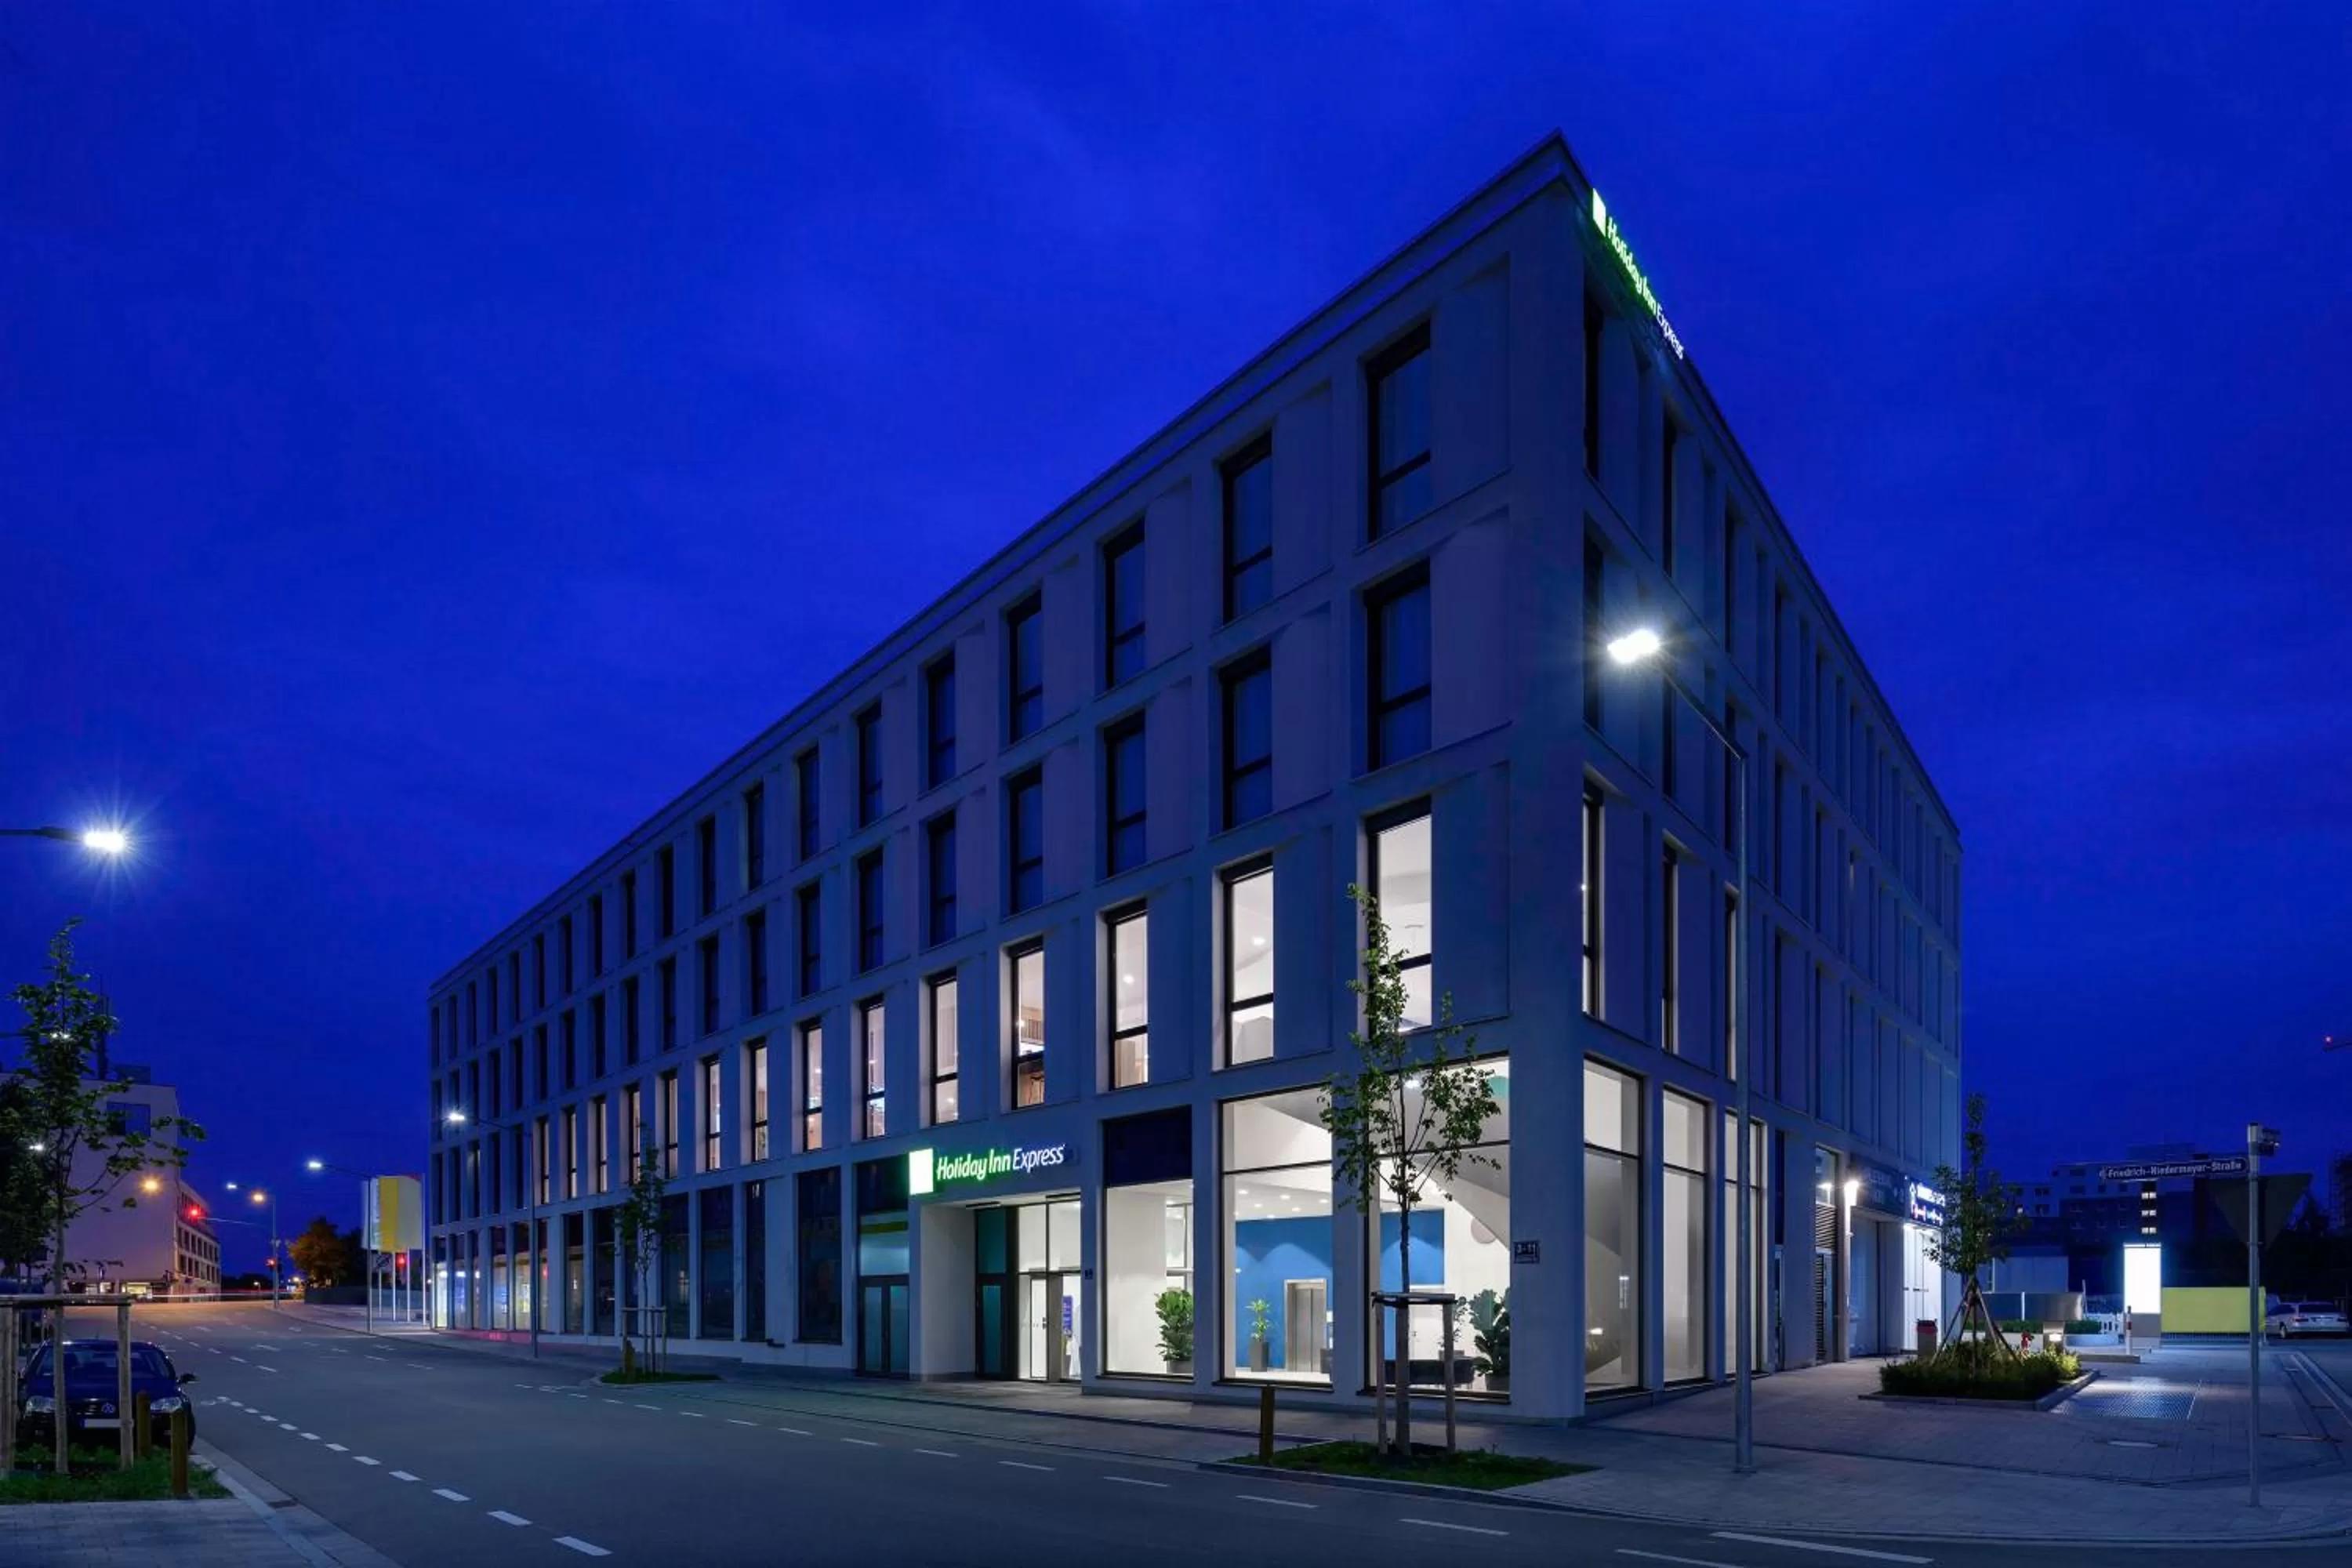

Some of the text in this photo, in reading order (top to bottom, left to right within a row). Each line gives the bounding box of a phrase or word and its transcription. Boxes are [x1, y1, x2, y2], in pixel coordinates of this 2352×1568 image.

[1607, 216, 1685, 360] Holiday Inn Express
[936, 1146, 1065, 1181] Holiday Inn Express
